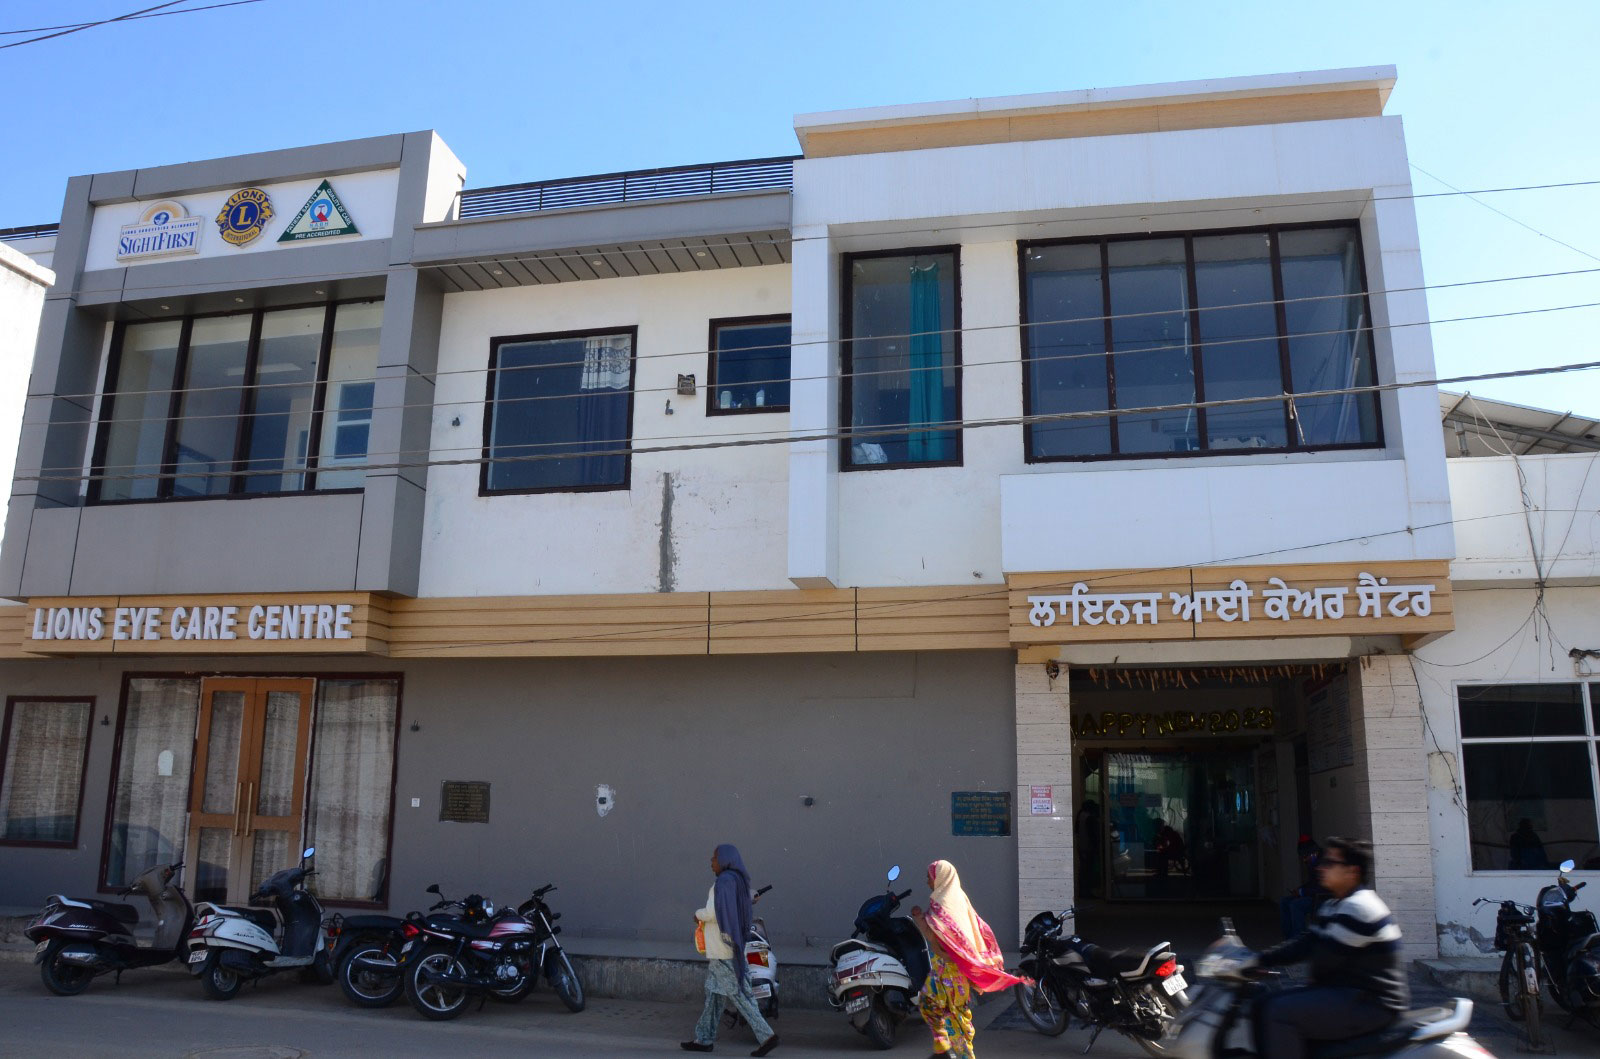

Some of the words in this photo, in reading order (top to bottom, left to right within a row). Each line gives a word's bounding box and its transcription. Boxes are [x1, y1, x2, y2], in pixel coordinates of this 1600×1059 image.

[231, 190, 264, 204] LIONS
[326, 188, 339, 207] QUALITY
[341, 212, 352, 226] CARE
[237, 206, 251, 226] L
[286, 212, 304, 233] PATIENT
[302, 195, 317, 215] SAFETY
[306, 229, 341, 238] ACCREDITED
[1170, 579, 1253, 623] ਆਈ
[1262, 577, 1349, 621] ਕੇਅਰ
[1356, 572, 1436, 619] ਸੈਂਟਰ
[32, 607, 104, 640] LIONS
[113, 607, 163, 640] EYE
[171, 606, 239, 640] CARE
[248, 604, 352, 640] CENTRE
[1154, 711, 1206, 735] NEW
[1209, 706, 1274, 734] 2023
